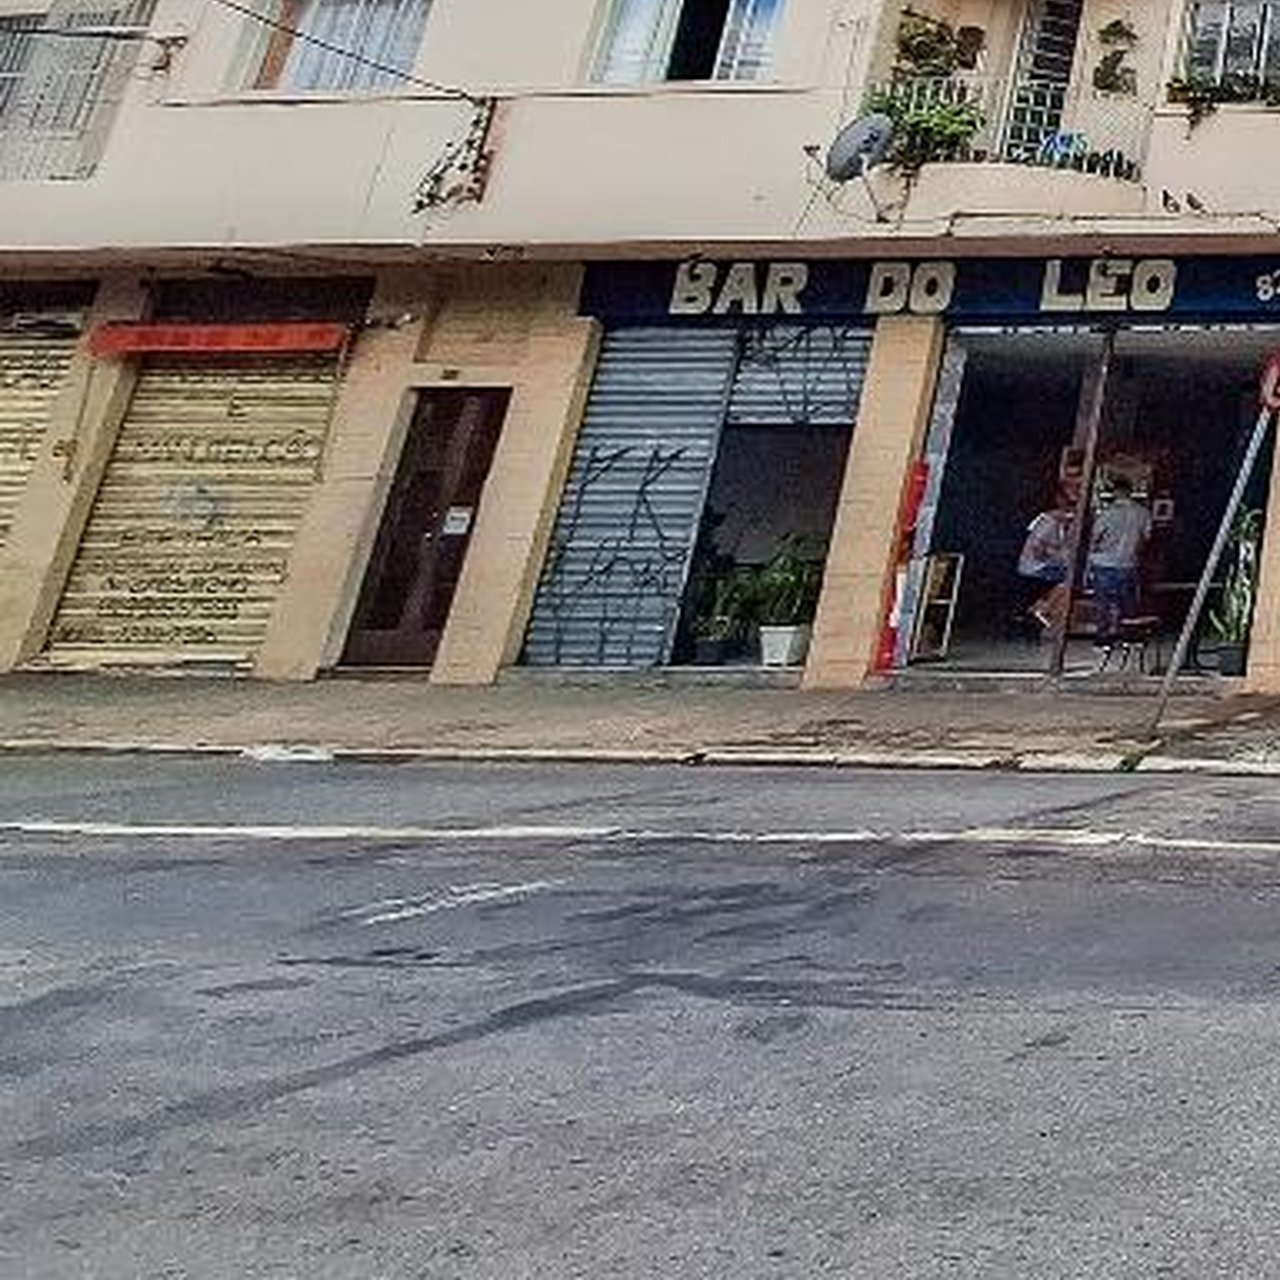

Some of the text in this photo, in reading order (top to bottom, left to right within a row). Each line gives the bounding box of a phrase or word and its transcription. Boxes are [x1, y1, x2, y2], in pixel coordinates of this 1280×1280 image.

[668, 259, 1177, 315] BAR DO LEO
